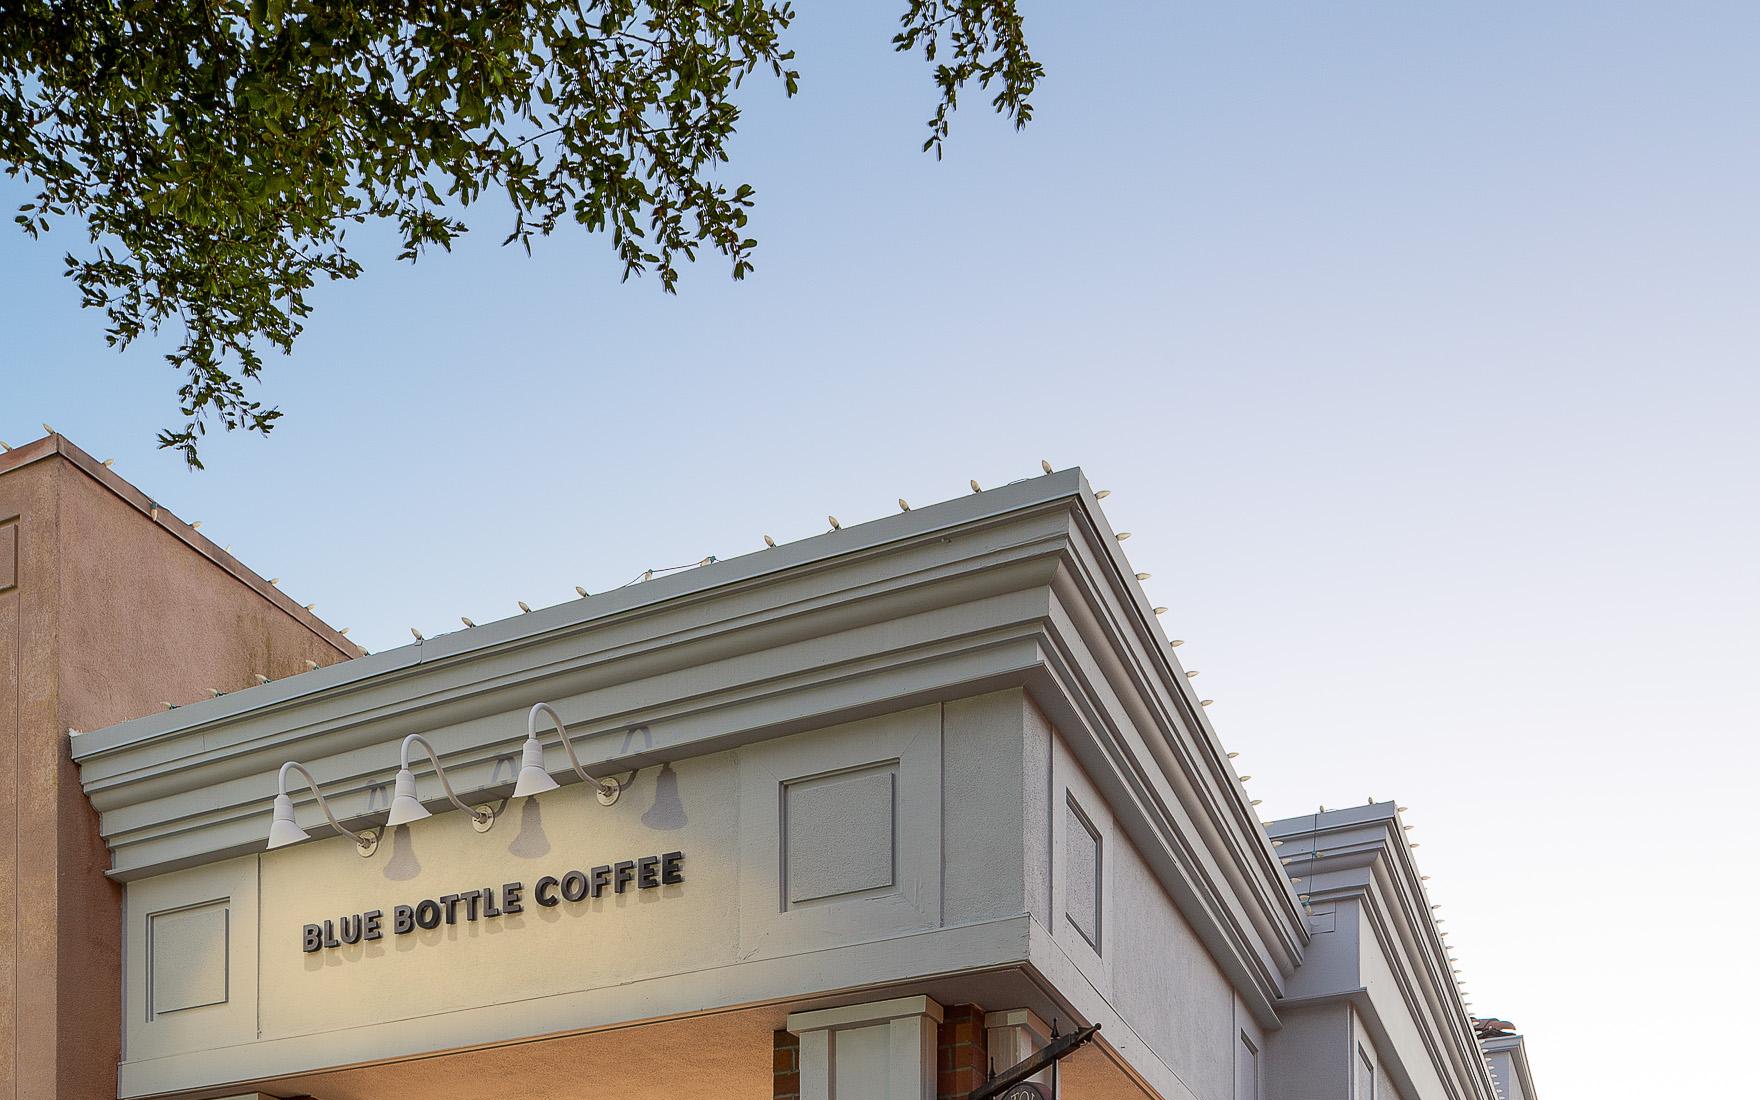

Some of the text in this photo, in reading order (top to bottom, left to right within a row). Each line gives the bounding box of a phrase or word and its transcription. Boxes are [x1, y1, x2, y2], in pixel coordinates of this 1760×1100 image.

[303, 851, 685, 953] BLUE BOTTLE COFFEE
